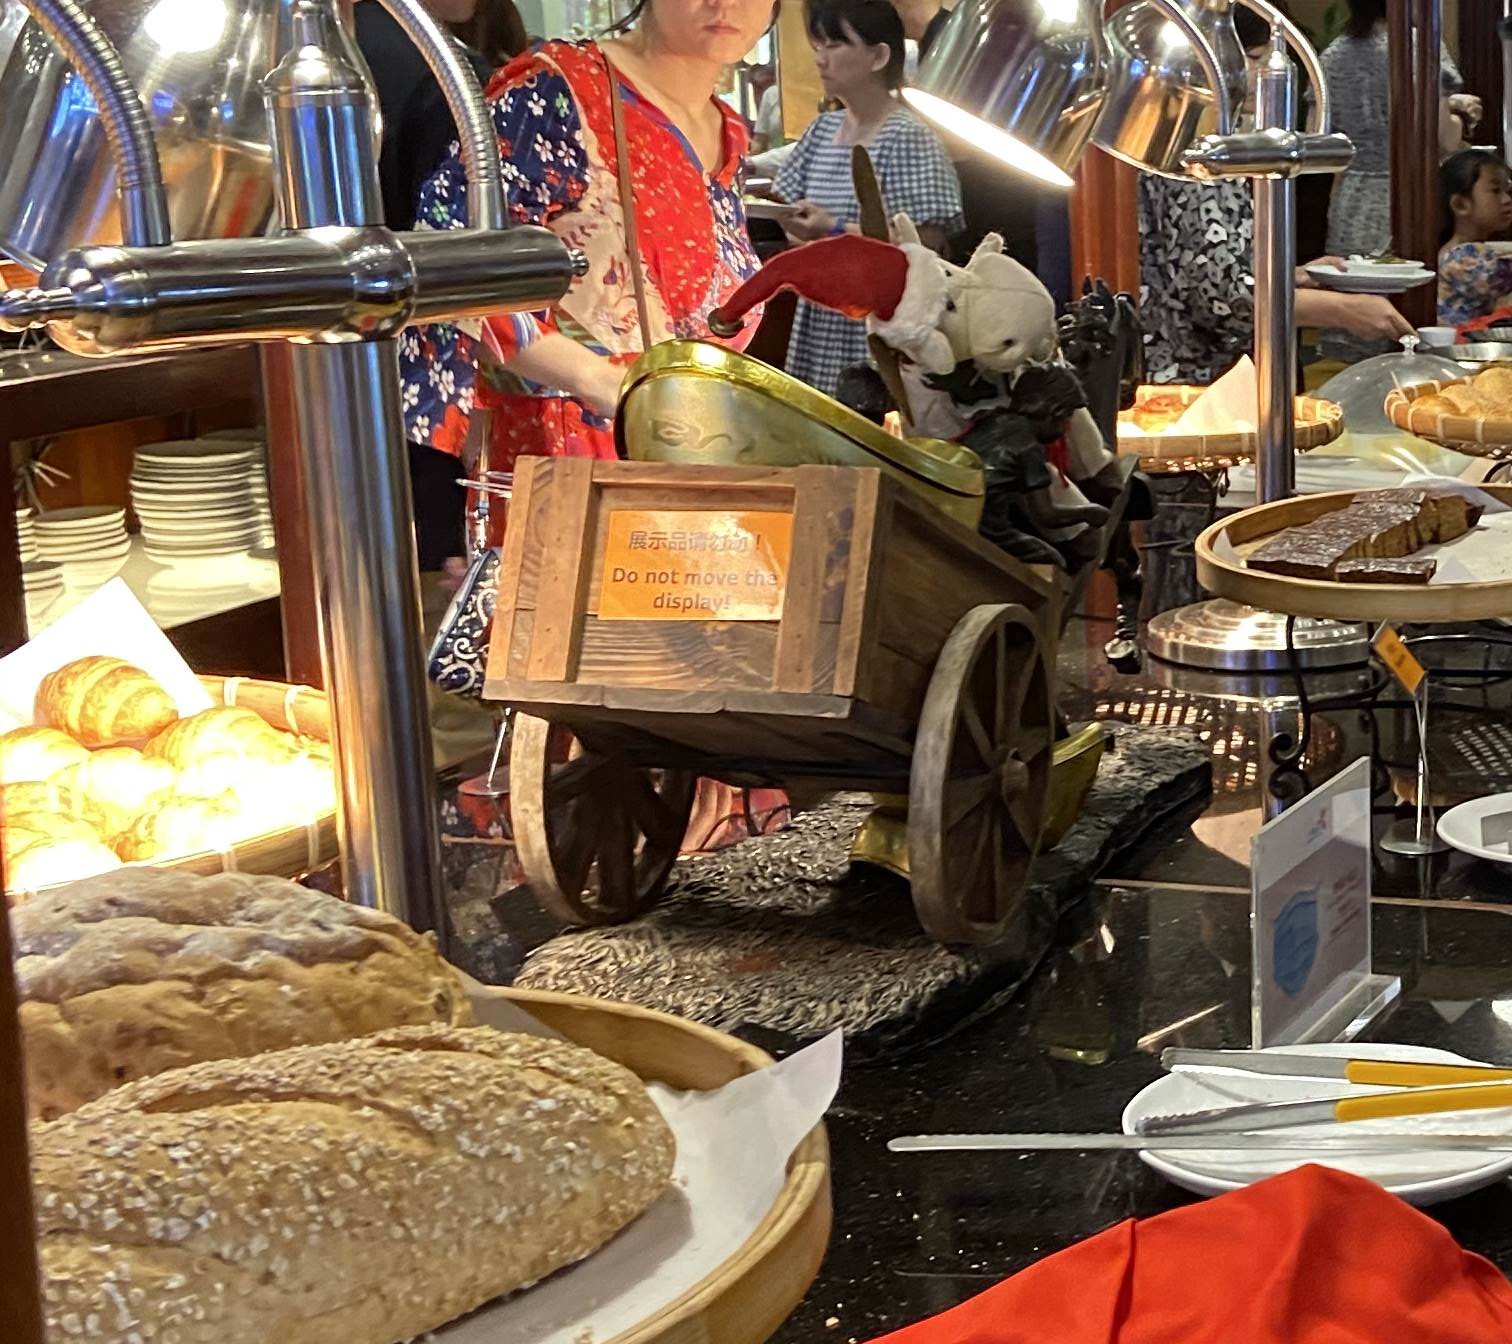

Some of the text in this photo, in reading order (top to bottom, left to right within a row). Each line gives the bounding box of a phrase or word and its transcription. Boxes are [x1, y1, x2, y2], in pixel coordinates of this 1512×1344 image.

[612, 567, 778, 587] Do not move the
[652, 591, 731, 613] display!
